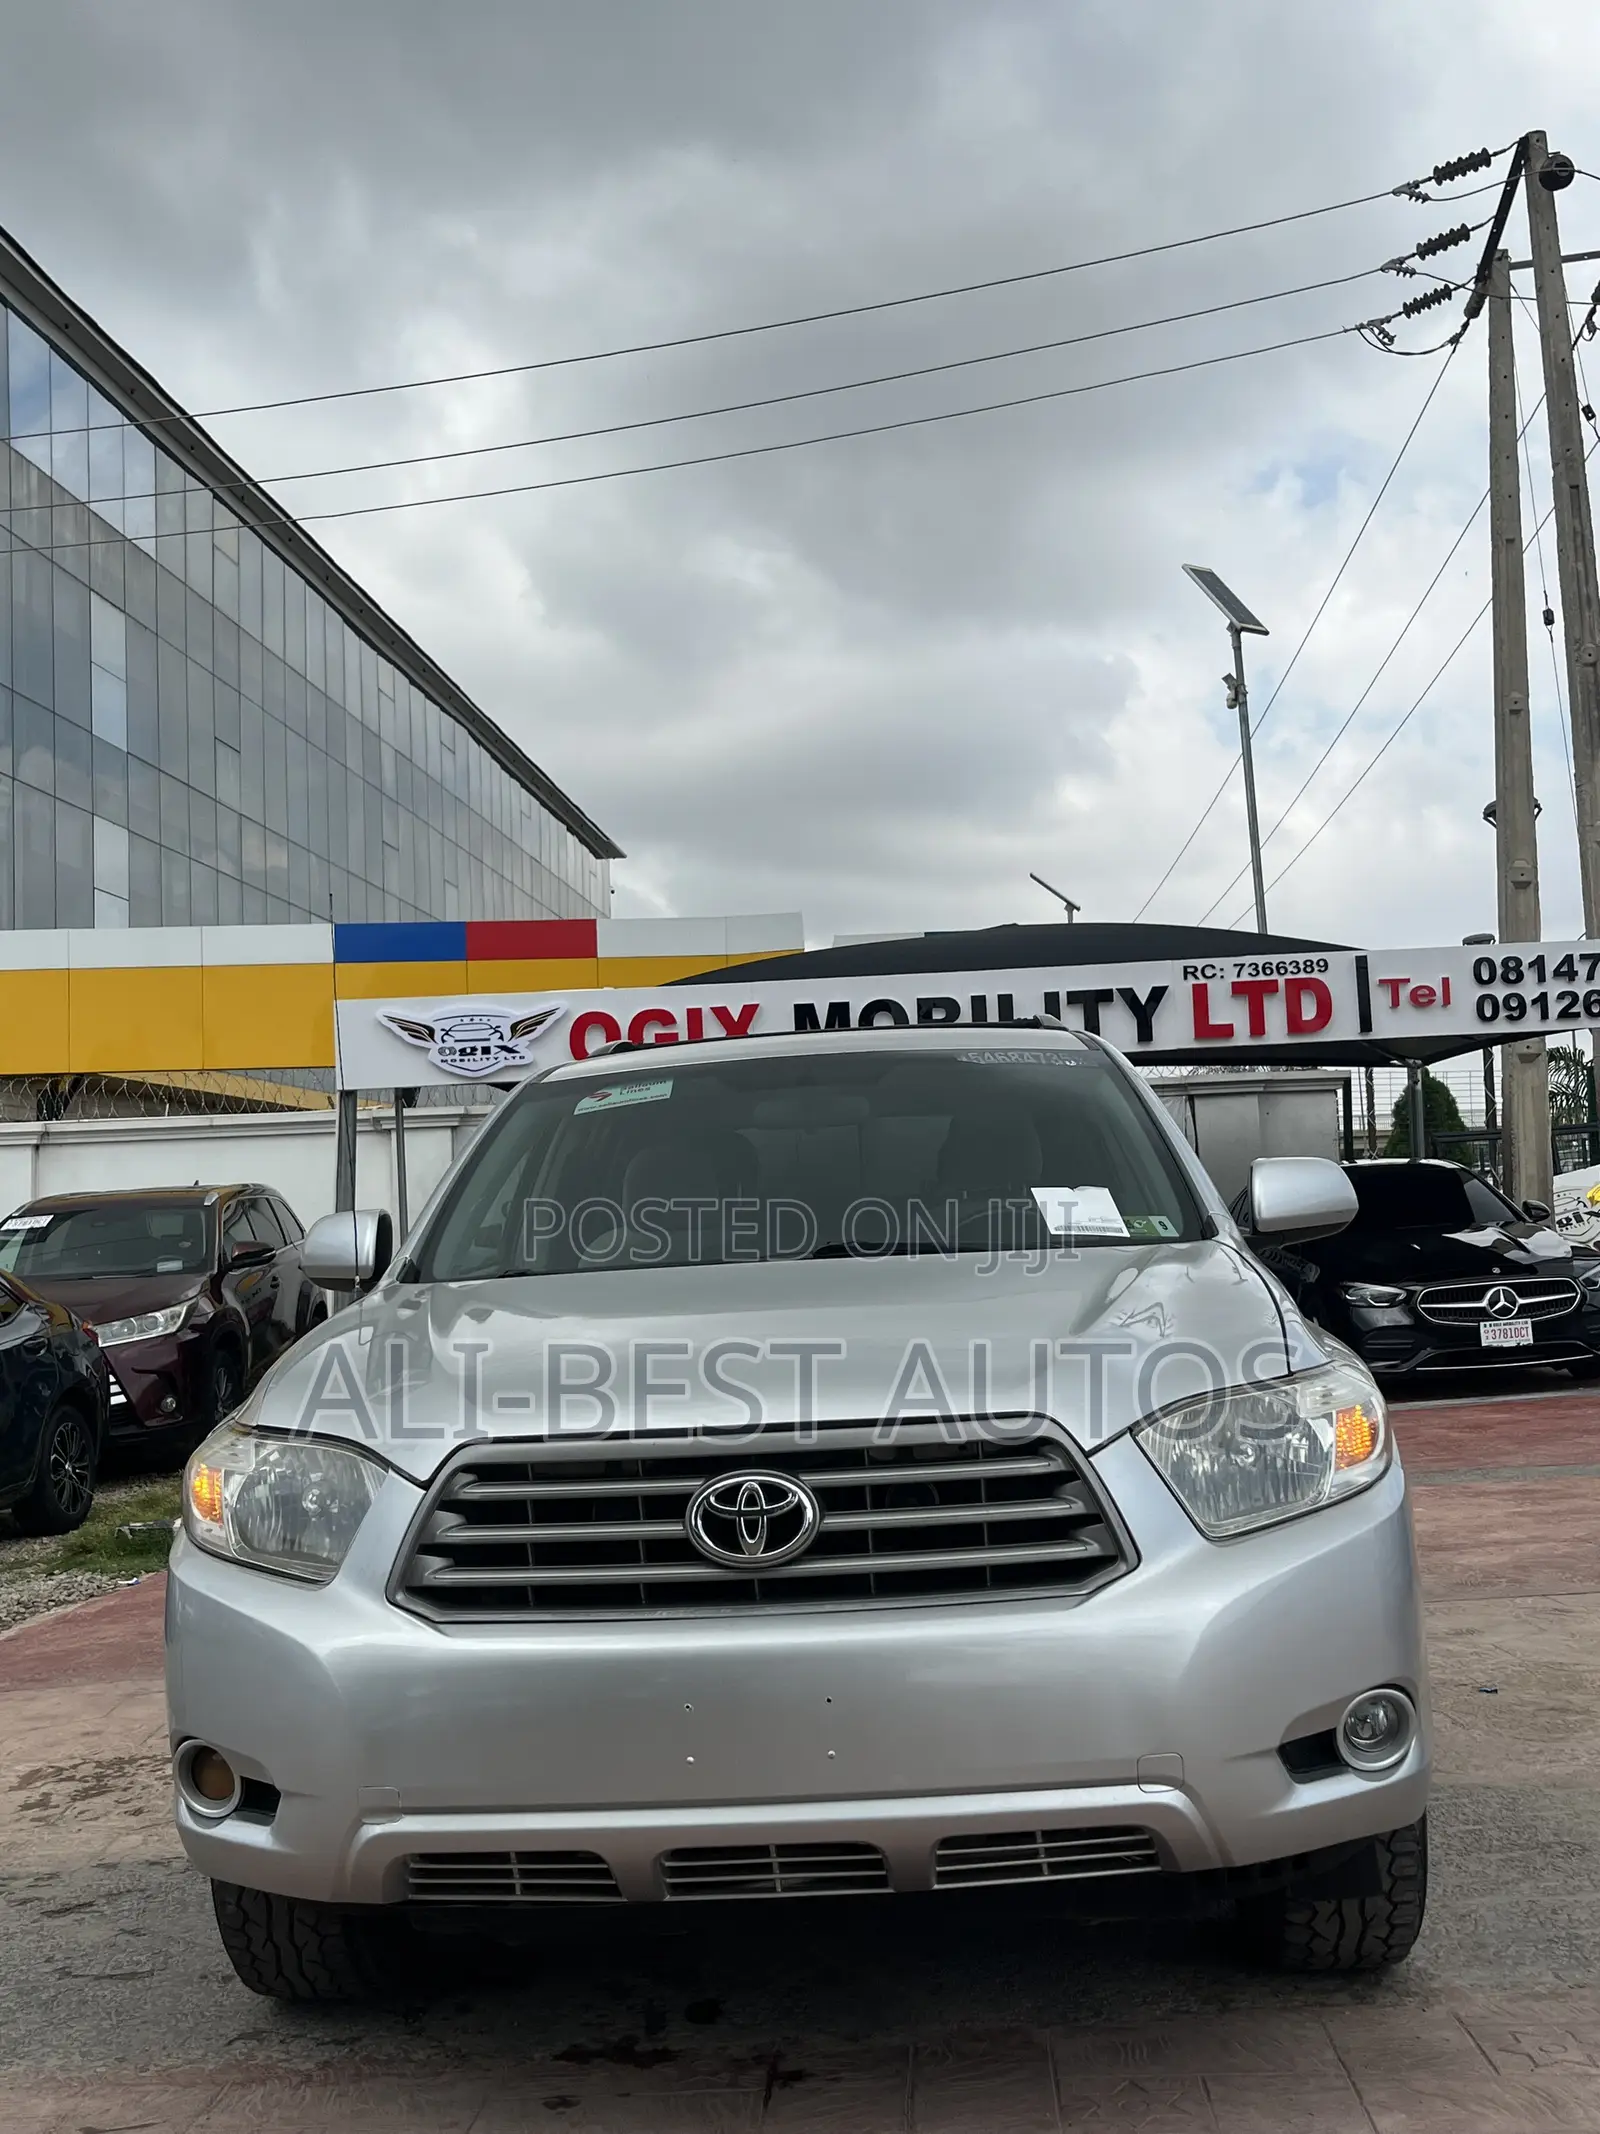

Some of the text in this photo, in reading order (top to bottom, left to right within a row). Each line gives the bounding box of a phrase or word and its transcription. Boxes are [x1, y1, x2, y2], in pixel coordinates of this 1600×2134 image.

[1183, 958, 1329, 980] RC: 7366389
[569, 1003, 760, 1061] OGIX
[1191, 977, 1333, 1039] LTD
[1377, 976, 1452, 1008] Tel
